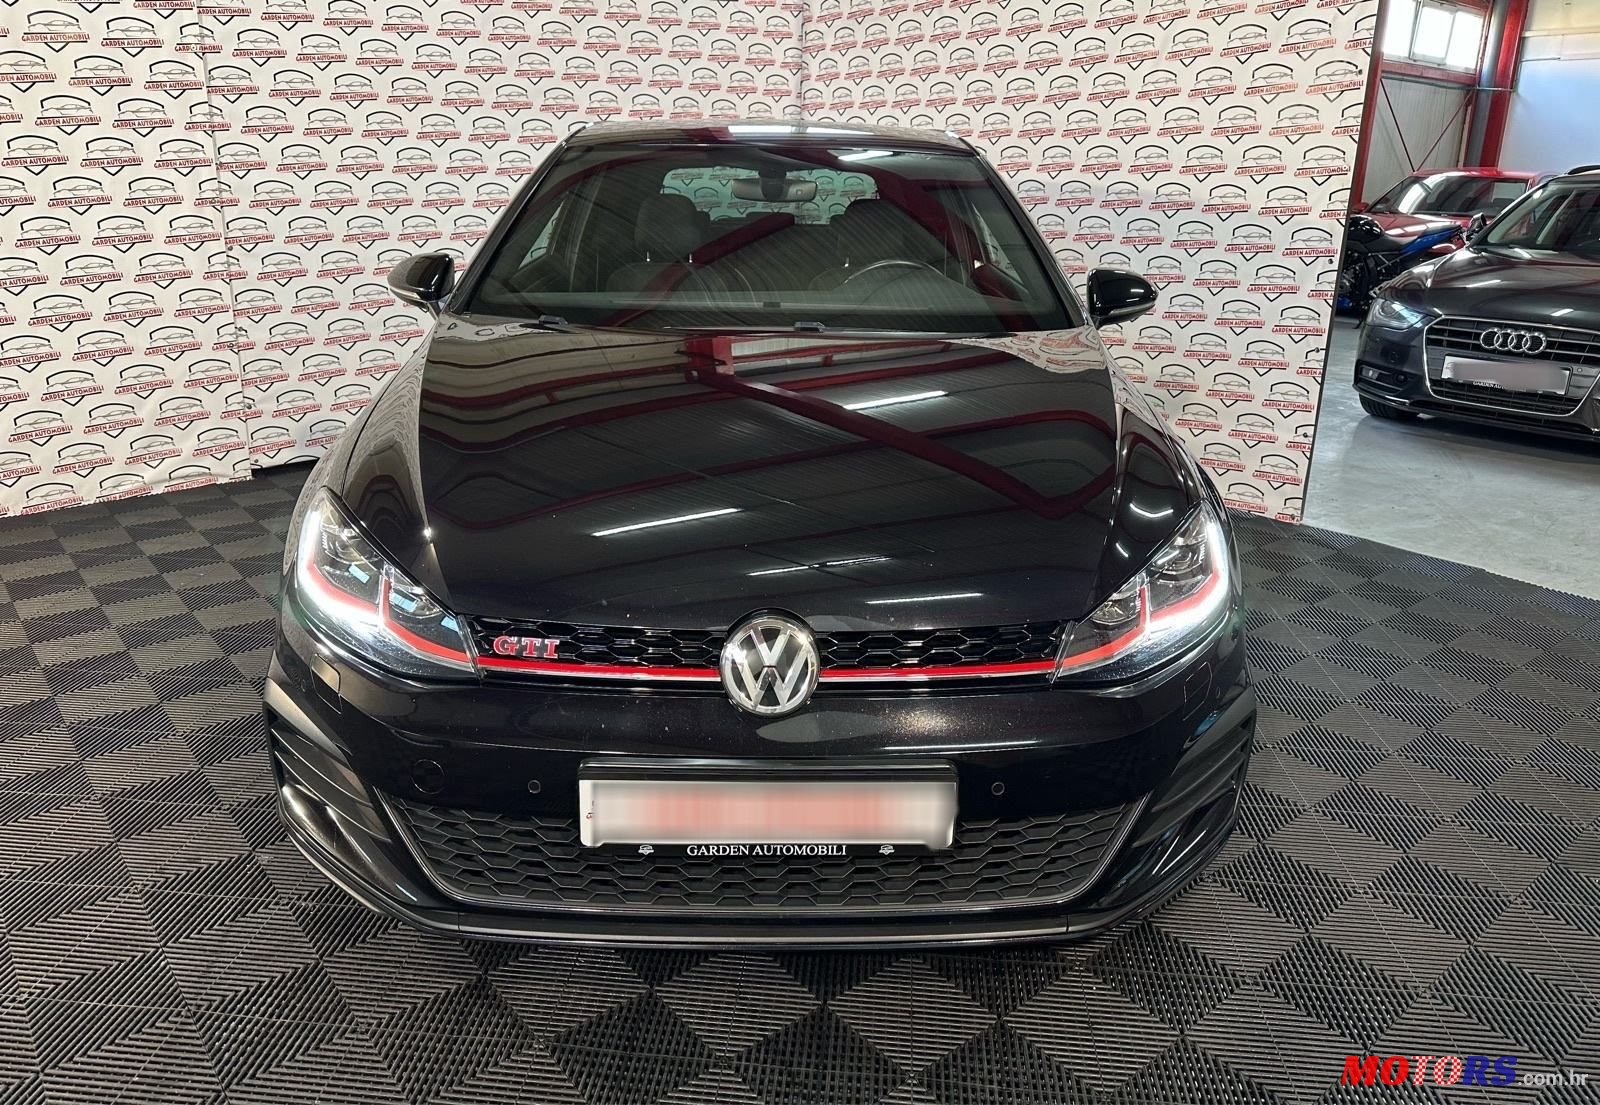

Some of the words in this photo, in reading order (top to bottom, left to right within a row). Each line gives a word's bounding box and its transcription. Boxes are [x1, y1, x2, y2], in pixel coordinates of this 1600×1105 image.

[1278, 44, 1301, 54] GARDEN
[1301, 38, 1337, 49] AUTOMOBILI
[16, 73, 57, 81] AUTOMOBILI
[34, 118, 60, 126] GARDEN
[61, 116, 101, 124] AUTOMOBILI
[137, 118, 174, 126] AUTOMOBILI
[1268, 128, 1289, 136] GARDEN
[1289, 124, 1324, 133] AUTOMOBILI
[29, 155, 69, 164] AUTOMOBILI
[106, 157, 144, 165] AUTOMOBILI
[178, 158, 213, 166] AUTOMOBILI
[47, 199, 72, 207] GARDEN
[73, 195, 113, 204] AUTOMOBILI
[147, 195, 184, 204] AUTOMOBILI
[14, 239, 40, 248] GARDEN
[41, 235, 81, 244] AUTOMOBILI
[91, 238, 116, 246] GARDEN
[117, 233, 154, 243] AUTOMOBILI
[164, 236, 186, 244] GARDEN
[187, 232, 222, 241] AUTOMOBILI
[59, 277, 84, 285] GARDEN
[85, 272, 123, 282] AUTOMOBILI
[133, 274, 156, 282] GARDEN
[157, 269, 193, 279] AUTOMOBILI
[103, 313, 127, 321] GARDEN
[128, 307, 164, 318] AUTOMOBILI
[174, 309, 196, 317] GARDEN
[197, 304, 231, 314] AUTOMOBILI
[28, 317, 53, 326] GARDEN
[54, 311, 93, 322] AUTOMOBILI
[72, 352, 96, 361] GARDEN
[97, 346, 134, 357] AUTOMOBILI
[144, 347, 167, 356] GARDEN
[168, 341, 202, 351] AUTOMOBILI
[114, 385, 137, 394] GARDEN
[138, 379, 174, 390] AUTOMOBILI
[183, 379, 205, 388] GARDEN
[206, 373, 239, 384] AUTOMOBILI
[40, 392, 65, 401] GARDEN
[66, 385, 104, 396] AUTOMOBILI
[154, 417, 176, 426] GARDEN
[177, 410, 211, 421] AUTOMOBILI
[83, 424, 107, 434] GARDEN
[108, 417, 144, 429] AUTOMOBILI
[8, 432, 33, 442] GARDEN
[34, 424, 73, 437] AUTOMOBILI
[124, 455, 147, 465] GARDEN
[148, 448, 183, 460] AUTOMOBILI
[52, 464, 76, 474] GARDEN
[77, 456, 114, 469] AUTOMOBILI
[493, 635, 560, 659] GTI
[687, 844, 749, 856] GARDEN
[752, 844, 847, 856] AUTOMOBILI
